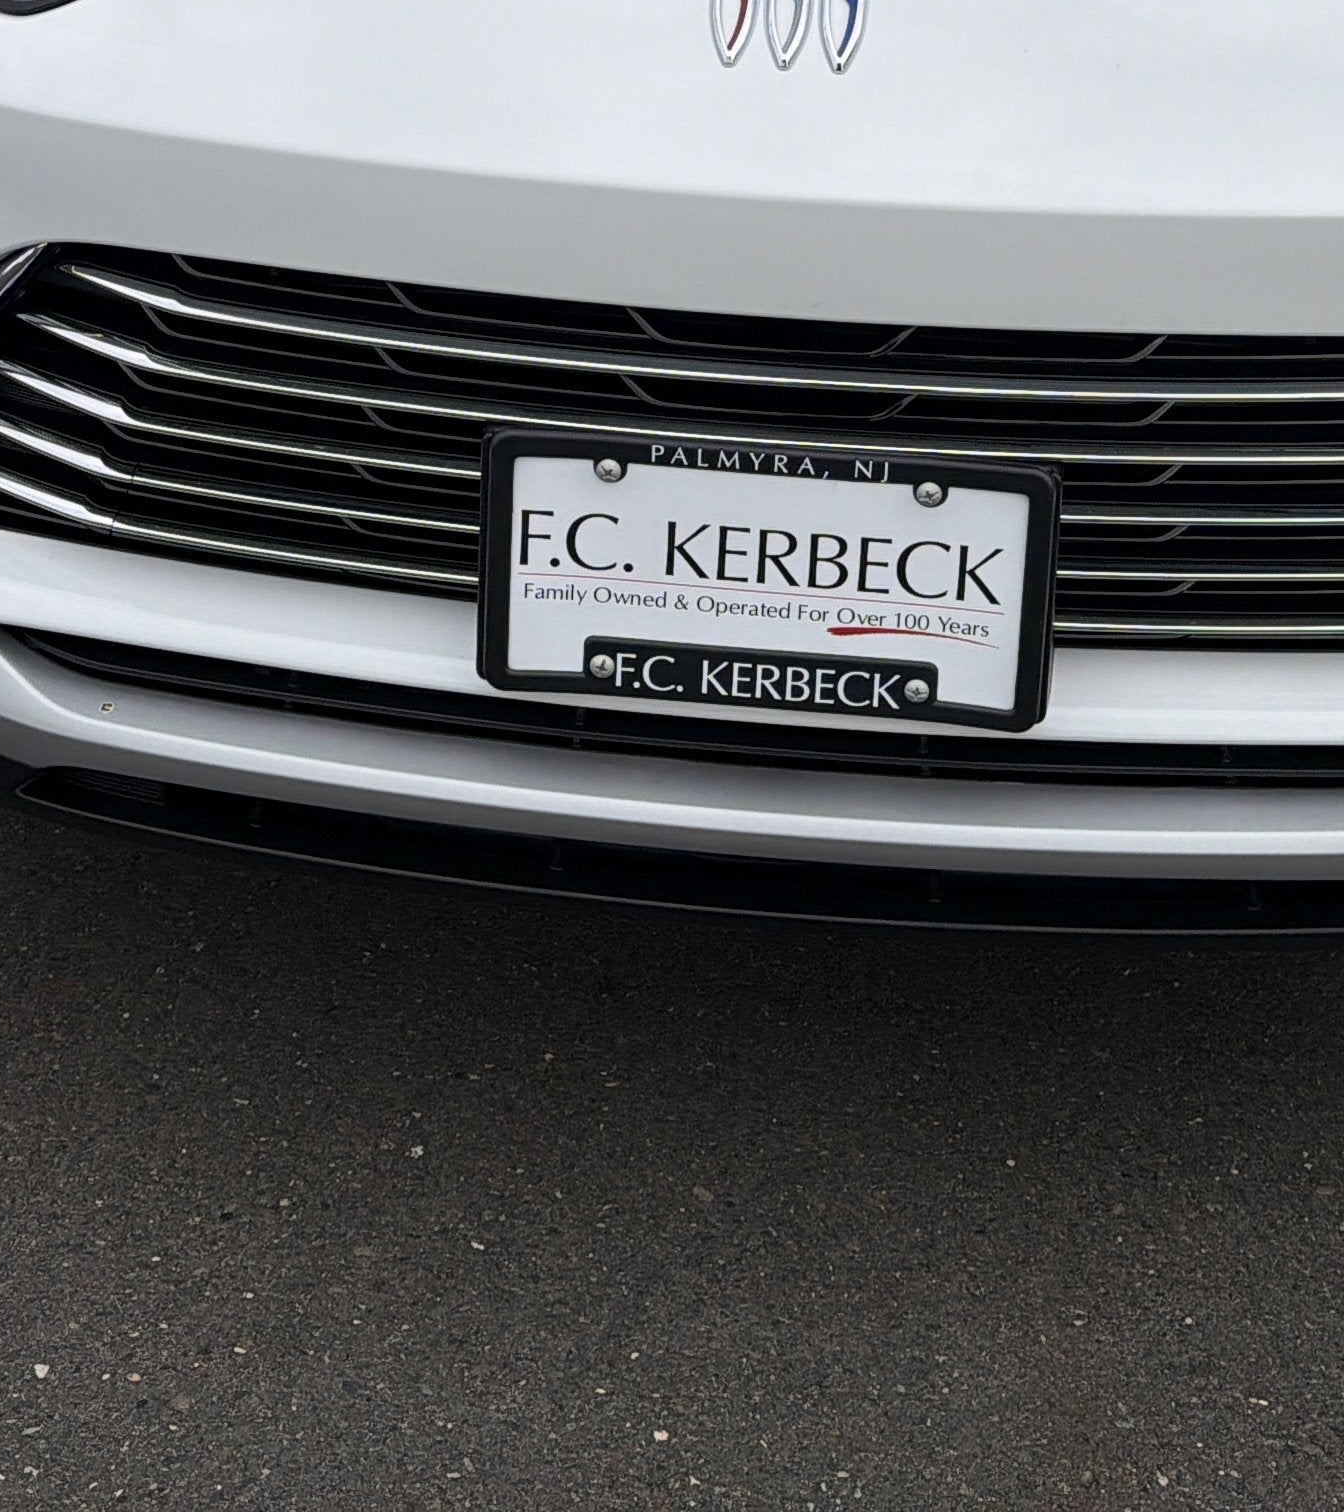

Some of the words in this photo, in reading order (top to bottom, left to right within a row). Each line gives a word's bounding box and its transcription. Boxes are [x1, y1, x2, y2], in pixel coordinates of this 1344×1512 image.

[650, 444, 831, 480] PALMYRA,
[854, 460, 890, 483] NJ
[519, 509, 634, 573] F.C.
[665, 521, 1005, 606] KERBECK
[524, 582, 588, 606] Family
[593, 586, 668, 609] Owned
[674, 594, 690, 610] &
[696, 595, 791, 619] Operated
[798, 604, 829, 622] For
[837, 607, 887, 626] Over
[894, 612, 930, 630] 100
[938, 616, 990, 637] Years
[615, 652, 684, 693] F.C.
[701, 659, 901, 710] KERBECK
